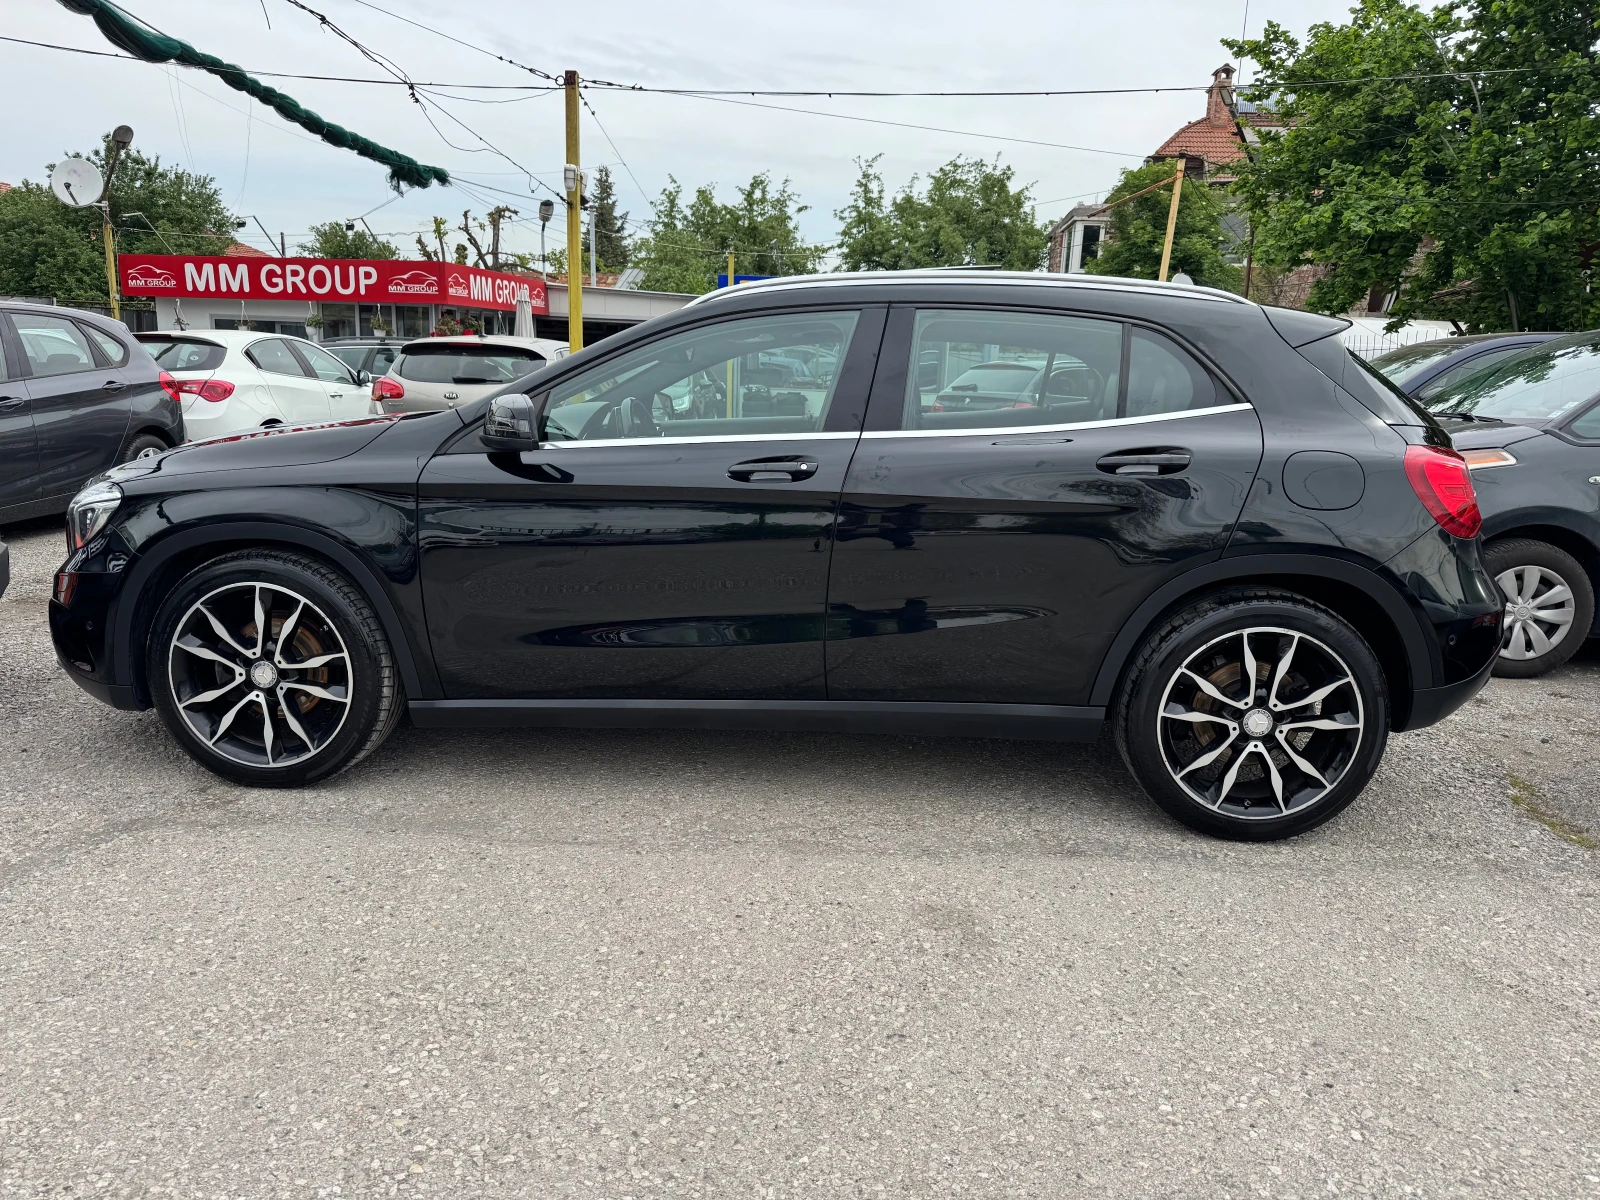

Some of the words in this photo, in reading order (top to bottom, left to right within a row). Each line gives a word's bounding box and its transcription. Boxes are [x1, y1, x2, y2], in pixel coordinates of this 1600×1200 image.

[184, 262, 250, 293] MM
[260, 263, 378, 296] GROUP
[469, 273, 493, 302] MM
